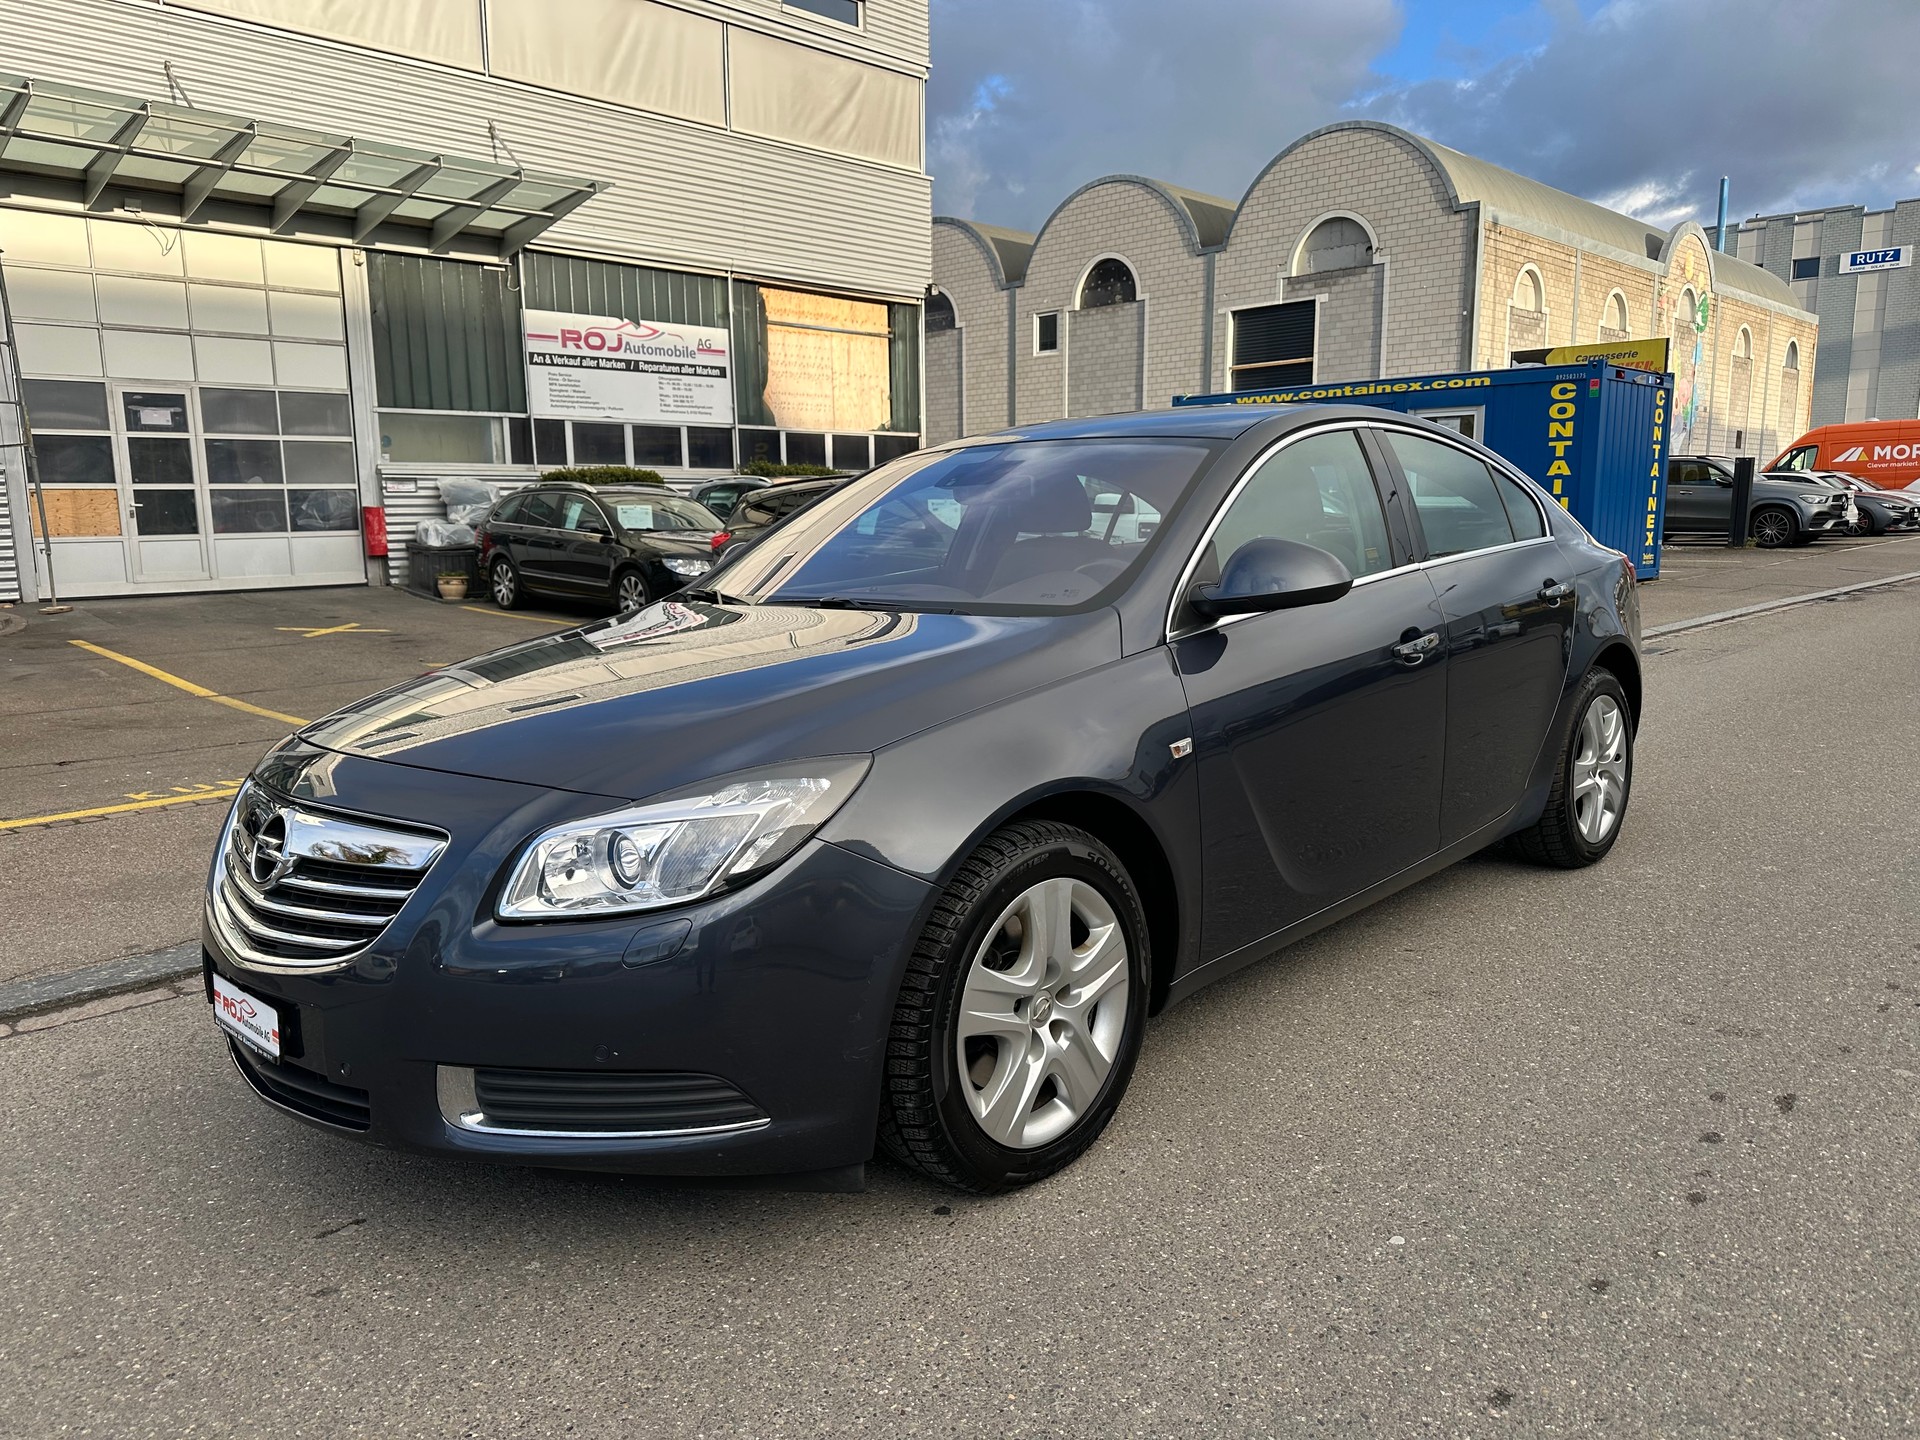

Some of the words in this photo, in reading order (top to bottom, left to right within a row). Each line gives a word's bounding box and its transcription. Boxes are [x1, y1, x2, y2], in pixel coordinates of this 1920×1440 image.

[1856, 251, 1894, 264] RUTZ
[560, 329, 623, 352] ROJ
[623, 341, 697, 359] Automobile
[697, 338, 712, 349] AG
[533, 354, 543, 363] An
[545, 355, 551, 364] &
[552, 354, 580, 366] Verkauf
[582, 358, 597, 367] aller
[599, 359, 626, 369] Marken
[639, 361, 680, 373] Reparaturen
[681, 364, 695, 374] aller
[696, 366, 720, 376] Marken
[1236, 376, 1491, 404] www.containex.com
[1645, 390, 1666, 546] CONTAINEX
[223, 995, 242, 1022] ROJ
